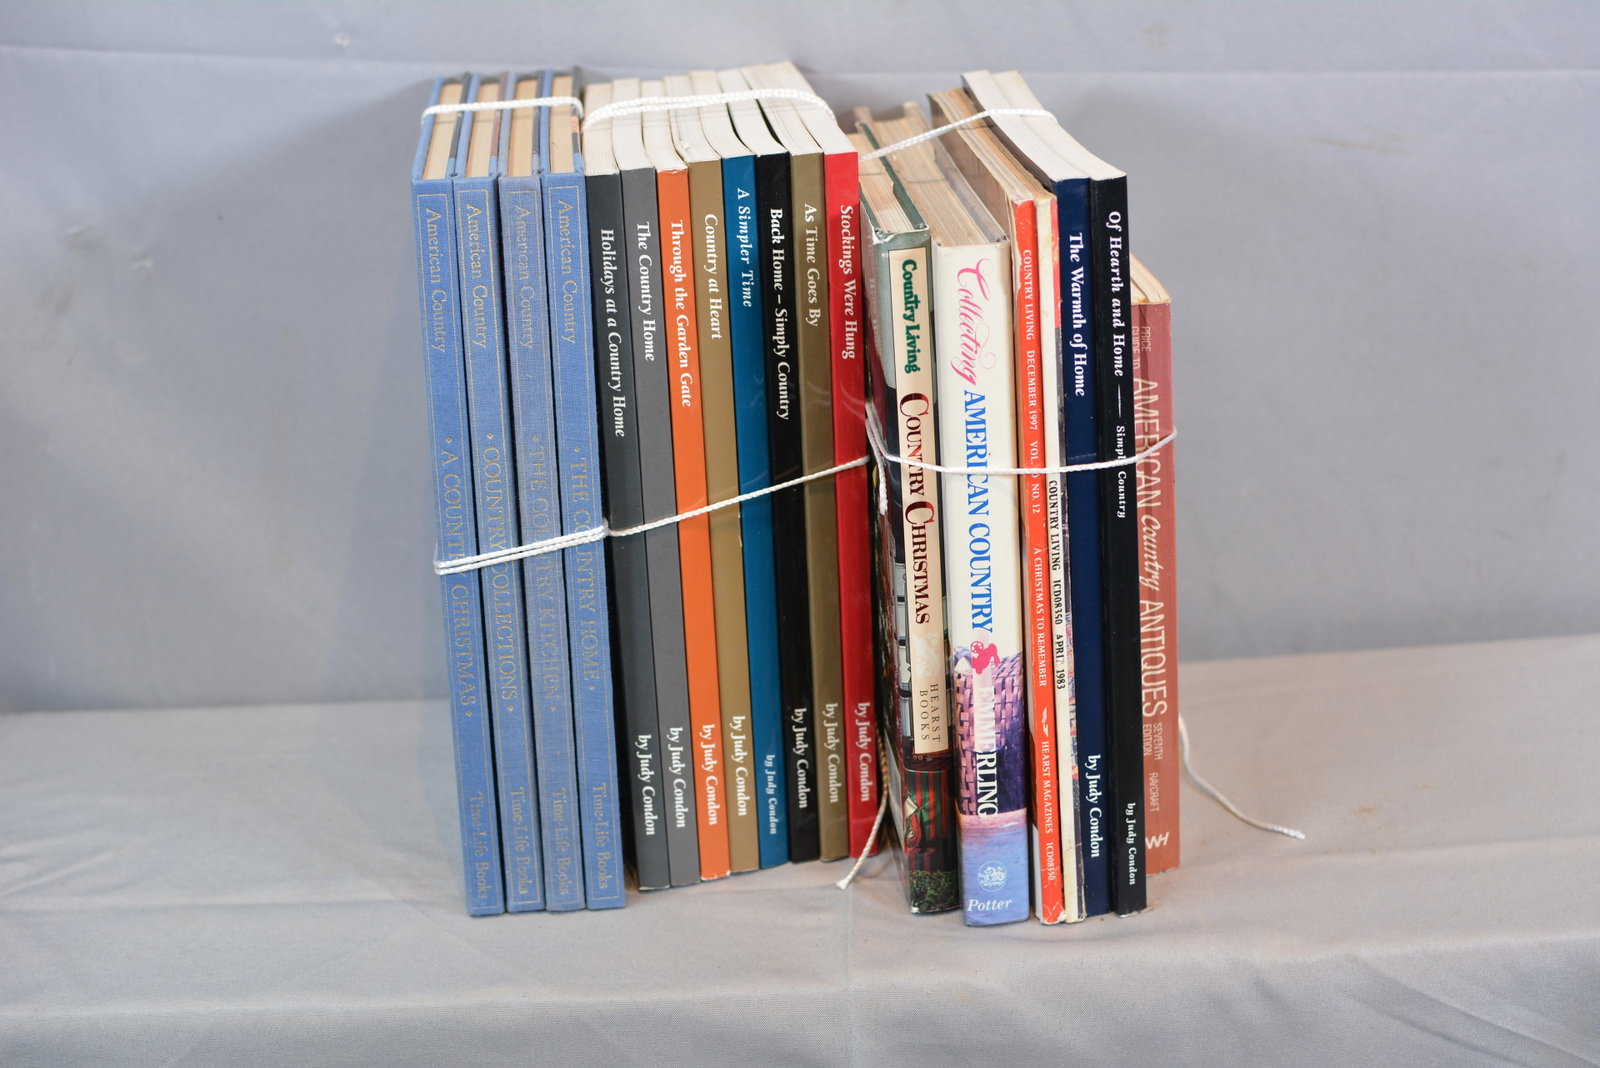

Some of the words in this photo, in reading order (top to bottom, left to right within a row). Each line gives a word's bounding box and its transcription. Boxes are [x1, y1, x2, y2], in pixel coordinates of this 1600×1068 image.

[737, 187, 750, 200] A
[804, 202, 818, 222] As
[558, 199, 576, 275] American
[636, 221, 651, 250] The
[736, 206, 753, 264] Simpler
[770, 208, 785, 245] Back
[838, 204, 853, 275] Stockings
[1106, 211, 1122, 232] Of
[425, 208, 443, 283] American
[466, 204, 485, 279] American
[515, 205, 532, 280] American
[669, 219, 687, 283] Through
[703, 213, 718, 275] Country
[805, 225, 818, 264] Time
[1069, 232, 1083, 262] The
[599, 228, 618, 295] Holidays
[771, 248, 785, 291] Home
[1023, 249, 1034, 299] COUNTRY
[1109, 235, 1124, 293] Hearth
[638, 254, 652, 315] Country
[673, 286, 688, 310] the
[708, 278, 719, 294] at
[741, 270, 754, 308] Time
[806, 267, 820, 304] Goes
[842, 279, 857, 316] Were
[902, 259, 921, 324] Country
[1070, 266, 1087, 329] Warmth
[431, 288, 447, 353] Country
[472, 284, 488, 348] Country
[519, 285, 535, 350] Country
[561, 280, 577, 344] Country
[604, 298, 617, 313] at
[606, 317, 616, 327] a
[709, 297, 722, 340] Heart
[805, 307, 821, 327] By
[950, 258, 997, 386] Collecting
[1025, 304, 1035, 340] LIVING
[1111, 297, 1125, 328] and
[642, 319, 656, 362] Home
[676, 314, 690, 368] Garden
[774, 307, 788, 358] Simply
[841, 320, 858, 360] Hung
[904, 324, 921, 374] Living
[1070, 333, 1087, 351] of
[1141, 326, 1151, 352] PRICE
[607, 331, 622, 392] Country
[1073, 352, 1087, 397] Home
[1112, 333, 1125, 377] Home
[1132, 360, 1140, 369] TO
[679, 372, 693, 407] Gate
[776, 361, 790, 420] Country
[1026, 350, 1037, 407] DECEMBER
[611, 395, 626, 437] Home
[1029, 410, 1038, 430] 1997
[1030, 441, 1038, 464] VOL.
[1115, 425, 1125, 462] Simpl
[482, 446, 505, 551] COUNTRY
[1031, 482, 1040, 501] NO.
[1032, 502, 1041, 514] 12
[1048, 480, 1059, 530] COUNTRY
[1117, 471, 1127, 518] Country
[569, 457, 589, 502] THE
[579, 619, 600, 681] HOME
[905, 500, 935, 625] CHRISTMAS
[1033, 547, 1042, 556] A
[1050, 531, 1060, 571] LIVING
[1139, 514, 1164, 592] Country
[441, 449, 458, 466] A
[451, 583, 476, 706] CHRISTMAS
[529, 445, 547, 491] THE
[539, 608, 561, 699] KITCHEN
[968, 522, 993, 633] COUNTRY
[1034, 558, 1044, 615] CHRISTMAS
[1036, 616, 1045, 631] TO
[1037, 633, 1047, 686] REMEMBER
[1139, 599, 1167, 718] ANTIQUES
[1056, 670, 1065, 690] 1983
[729, 715, 746, 731] by
[791, 708, 807, 724] by
[822, 702, 838, 718] by
[854, 701, 870, 718] by
[920, 690, 930, 741] BOOKS
[930, 683, 941, 743] HEARST
[635, 734, 651, 750] by
[666, 726, 683, 742] by
[699, 724, 715, 740] by
[731, 733, 747, 764] Judy
[792, 725, 808, 756] Judy
[823, 720, 838, 752] Judy
[855, 719, 871, 751] Judy
[1143, 724, 1151, 756] EDITION
[1153, 722, 1163, 761] SEVENTH
[636, 751, 652, 784] Judy
[668, 744, 684, 776] Judy
[700, 741, 716, 773] Judy
[763, 754, 775, 767] by
[1041, 741, 1050, 777] HEARST
[1085, 754, 1101, 770] by
[734, 766, 750, 816] Condon
[764, 769, 776, 795] Judy
[796, 758, 811, 809] Condon
[827, 753, 840, 803] Condon
[859, 752, 872, 802] Condon
[1085, 771, 1102, 804] Judy
[510, 786, 530, 852] Time-Life
[592, 782, 611, 848] Time-Life
[642, 786, 658, 836] Condon
[672, 778, 688, 828] Condon
[705, 775, 720, 826] Condon
[768, 797, 778, 835] Condon
[1042, 779, 1053, 834] MAGAZINES
[1125, 802, 1136, 816] by
[1089, 807, 1103, 858] Condon
[1126, 818, 1136, 844] Judy
[476, 861, 492, 899] Books
[515, 856, 533, 894] Books
[557, 856, 573, 895] Books
[597, 850, 612, 889] Books
[1128, 847, 1137, 885] Condon
[967, 899, 1013, 912] Potter
